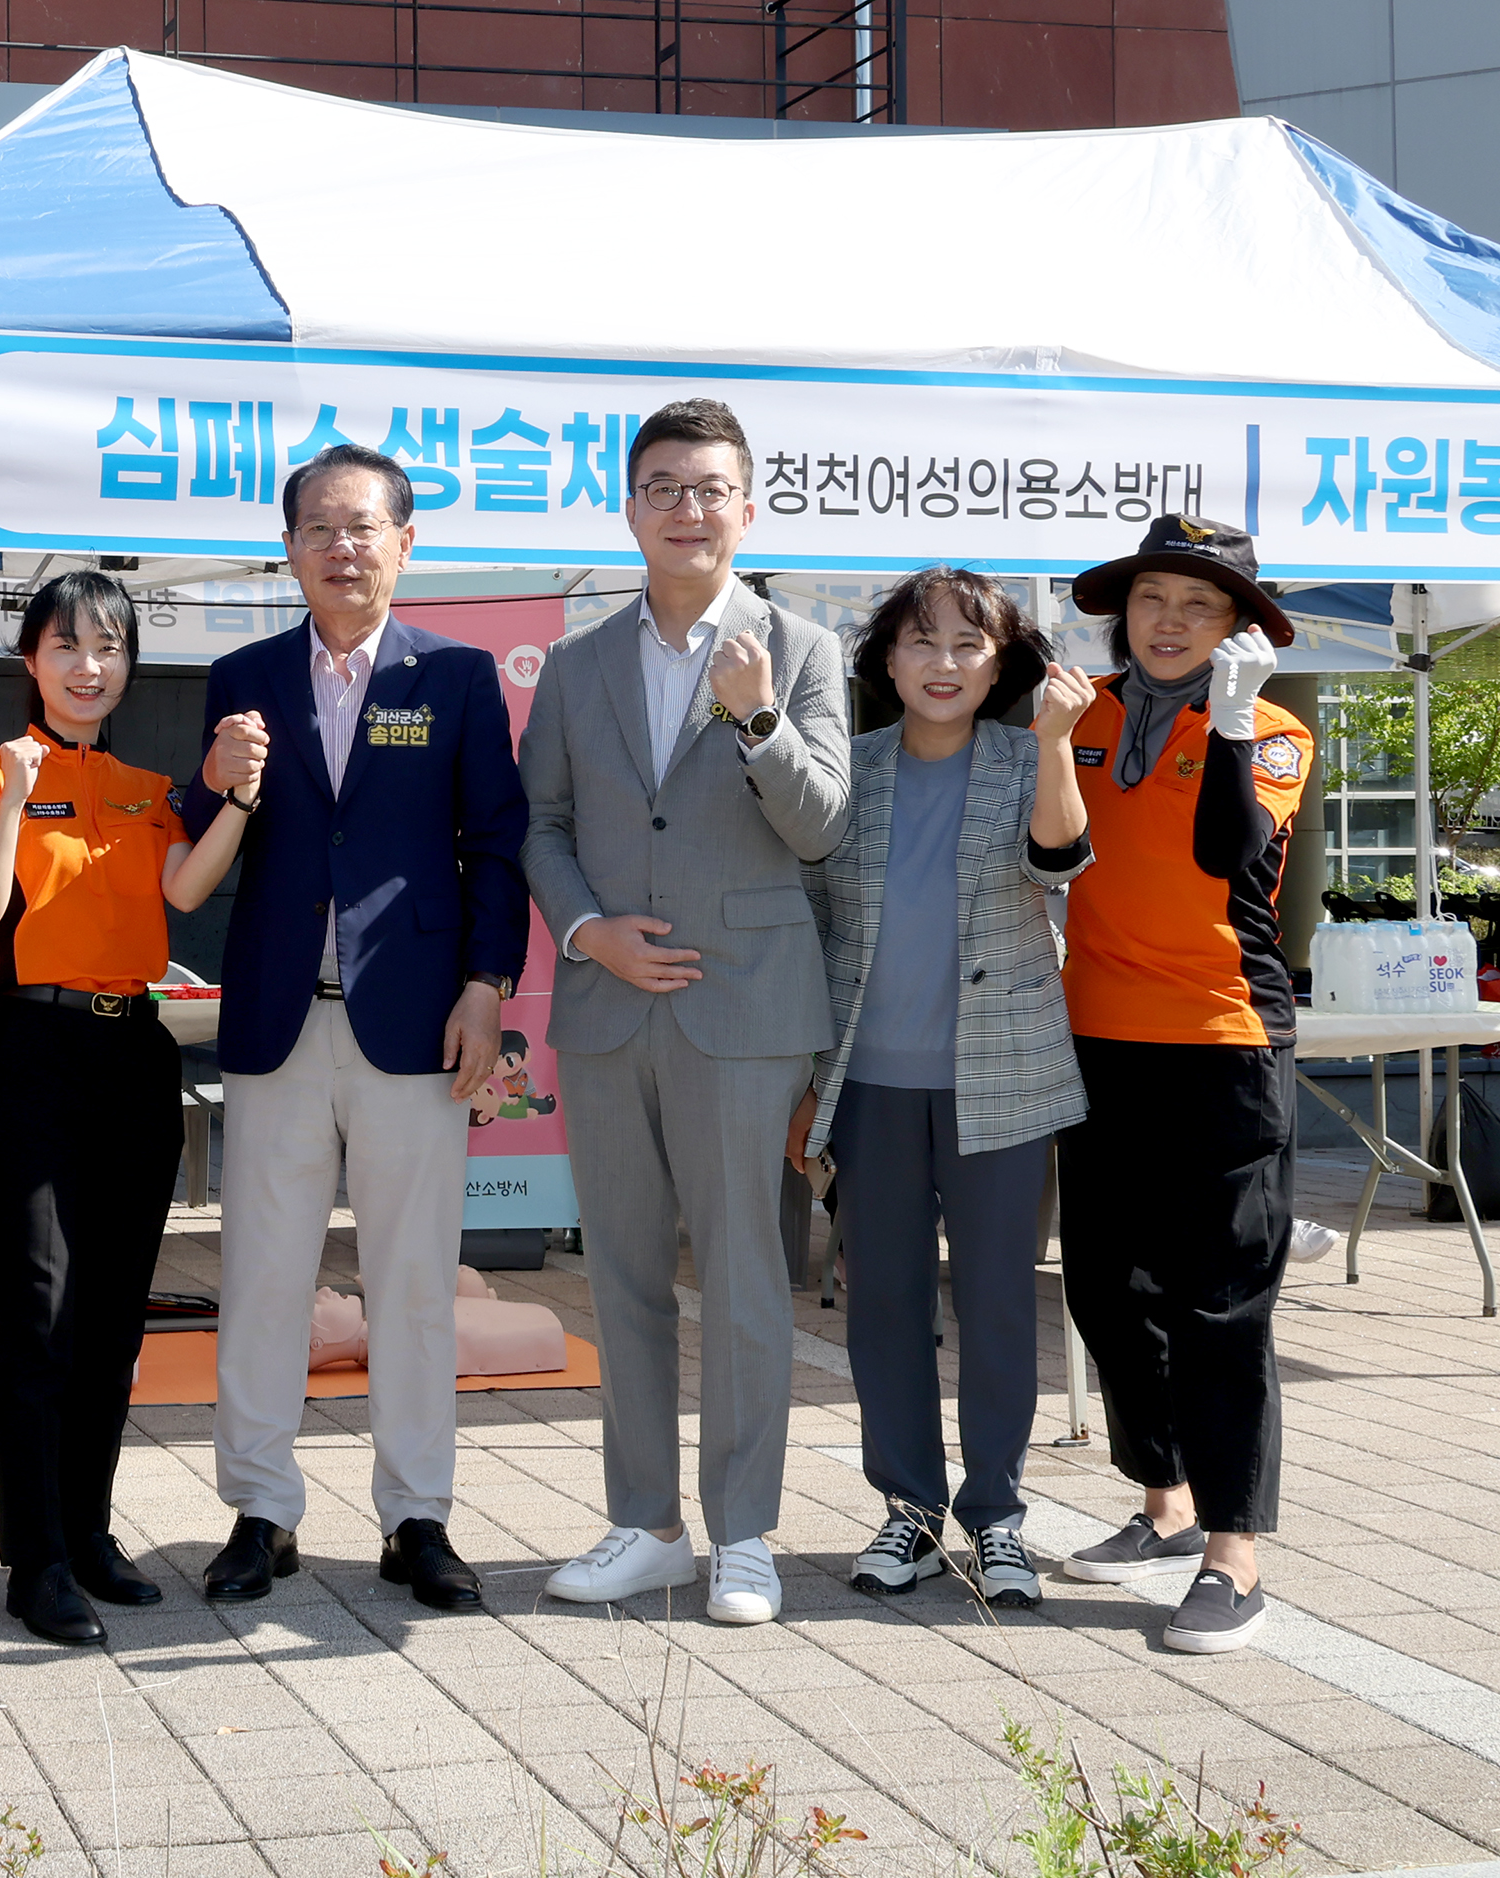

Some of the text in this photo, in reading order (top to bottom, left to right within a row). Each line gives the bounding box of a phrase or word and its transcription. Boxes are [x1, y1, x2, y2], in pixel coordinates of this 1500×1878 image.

[765, 451, 1202, 521] 청천여성의용소방대
[375, 711, 424, 725] 괴산군수
[370, 725, 428, 745] 송인헌
[1429, 956, 1432, 967] I
[1376, 961, 1406, 978] 석수
[1429, 967, 1464, 980] SEOK
[1429, 981, 1446, 993] SU
[466, 1180, 528, 1197] 산소방서
